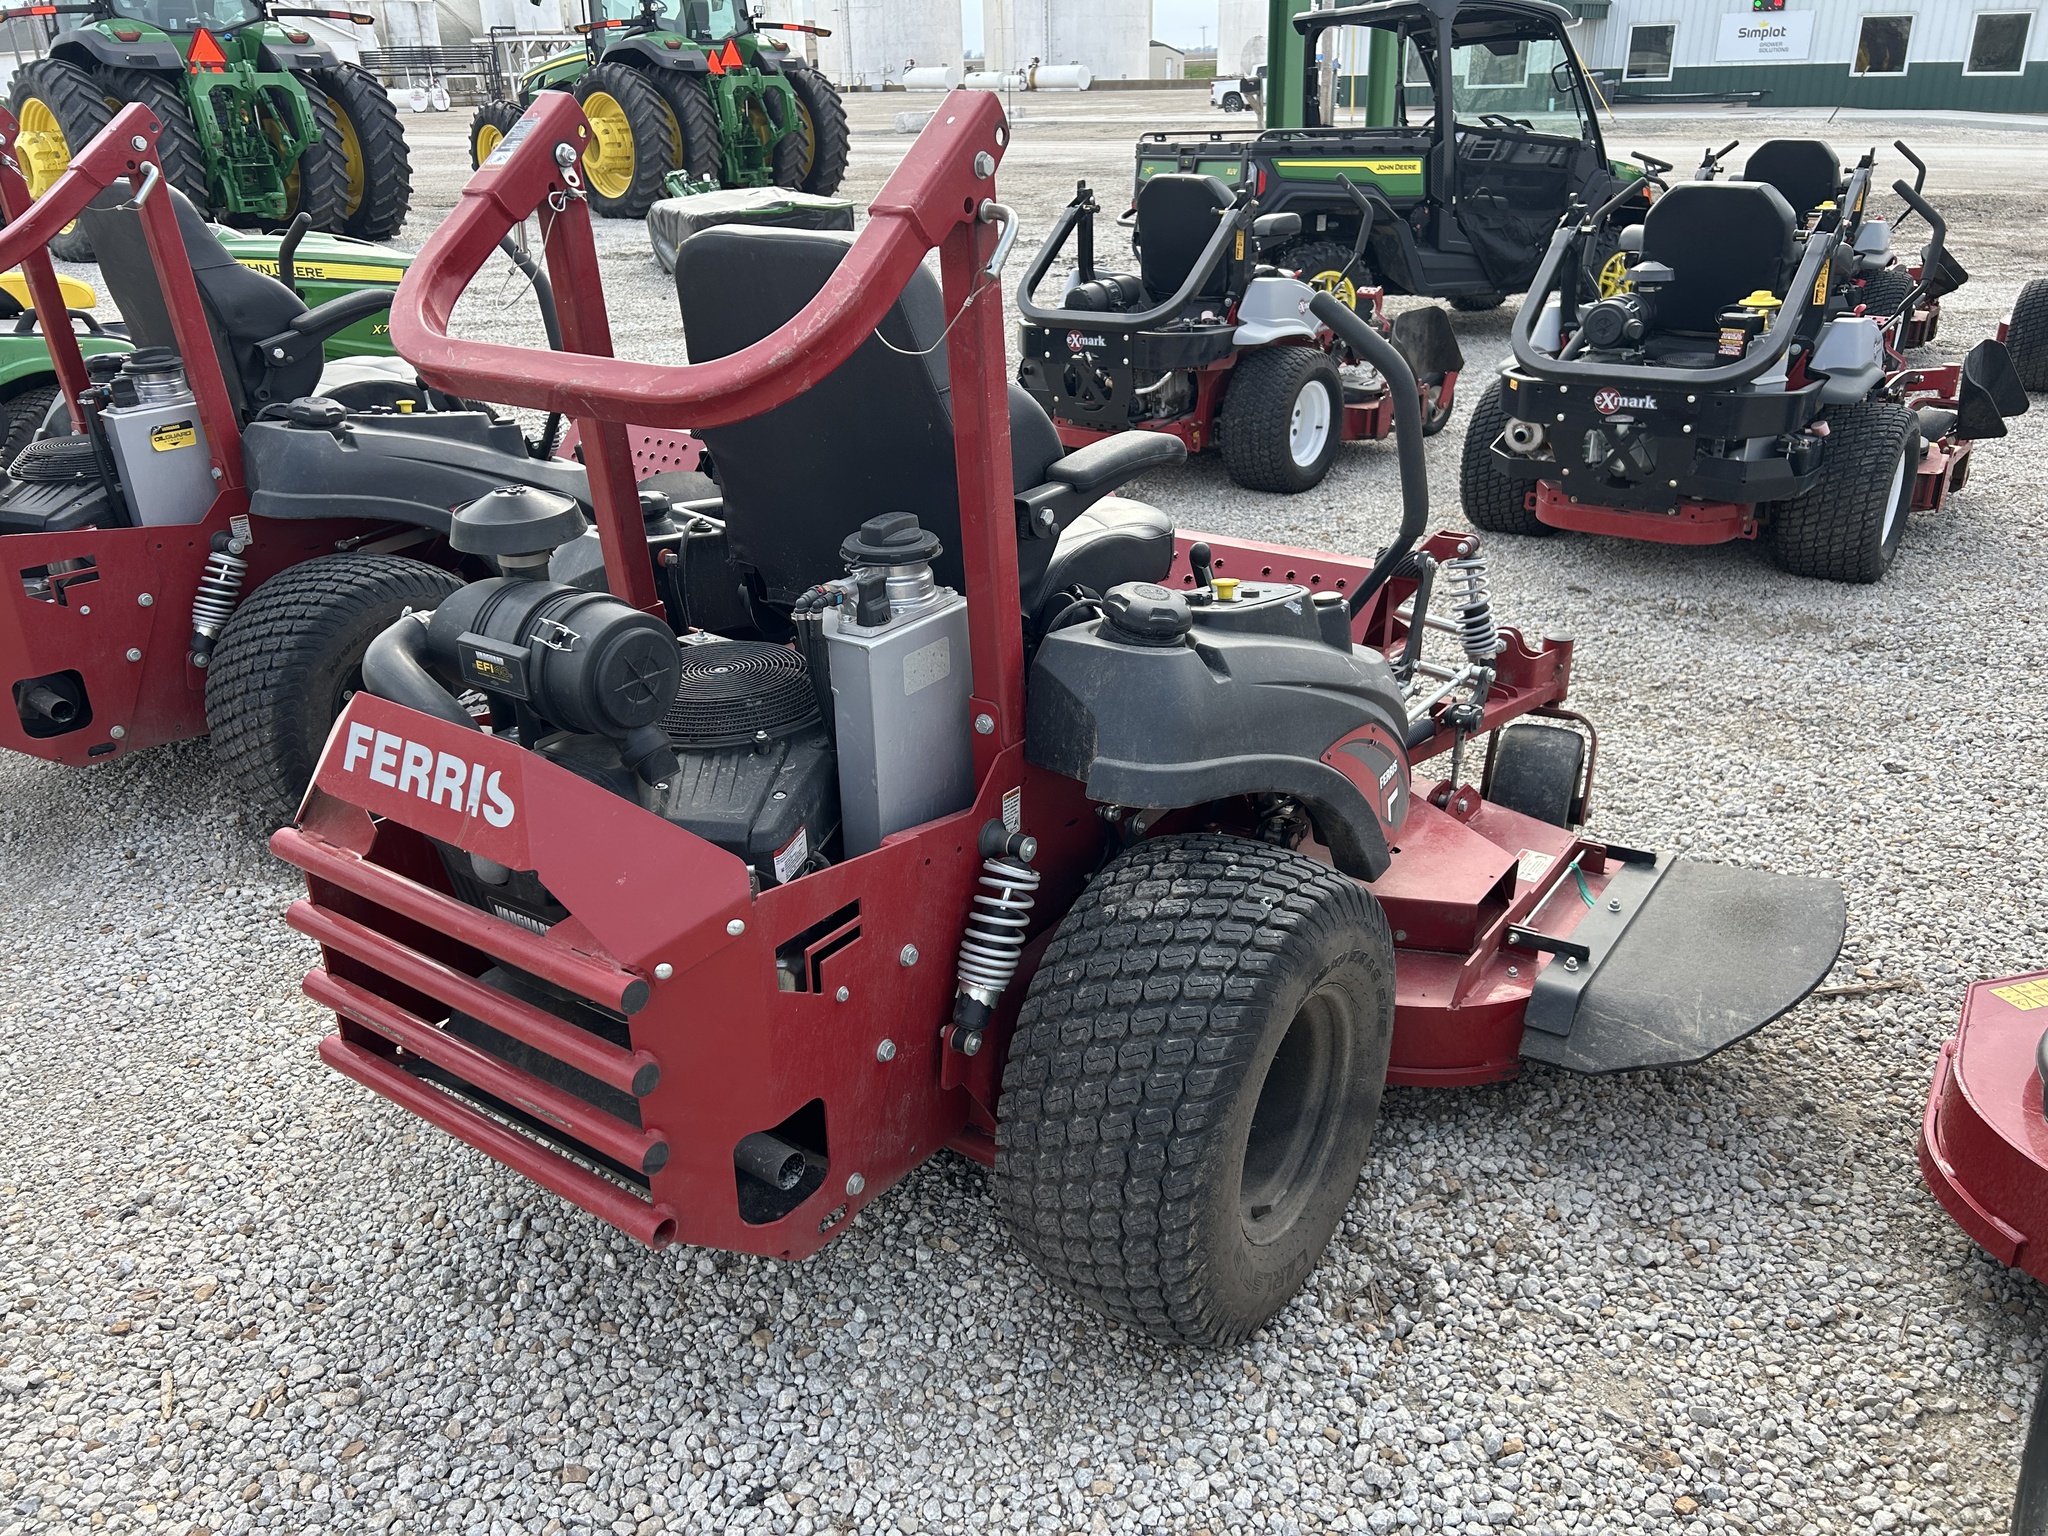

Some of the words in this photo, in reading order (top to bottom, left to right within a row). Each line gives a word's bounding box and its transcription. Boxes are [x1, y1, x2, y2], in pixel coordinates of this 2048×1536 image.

[1738, 26, 1787, 41] Simplot
[1376, 163, 1394, 171] JOHN
[1395, 163, 1417, 171] DEERE
[1066, 333, 1107, 347] eXmark
[1594, 392, 1658, 410] eXmark
[343, 721, 515, 828] FERRIS
[1379, 759, 1398, 790] FERRIS
